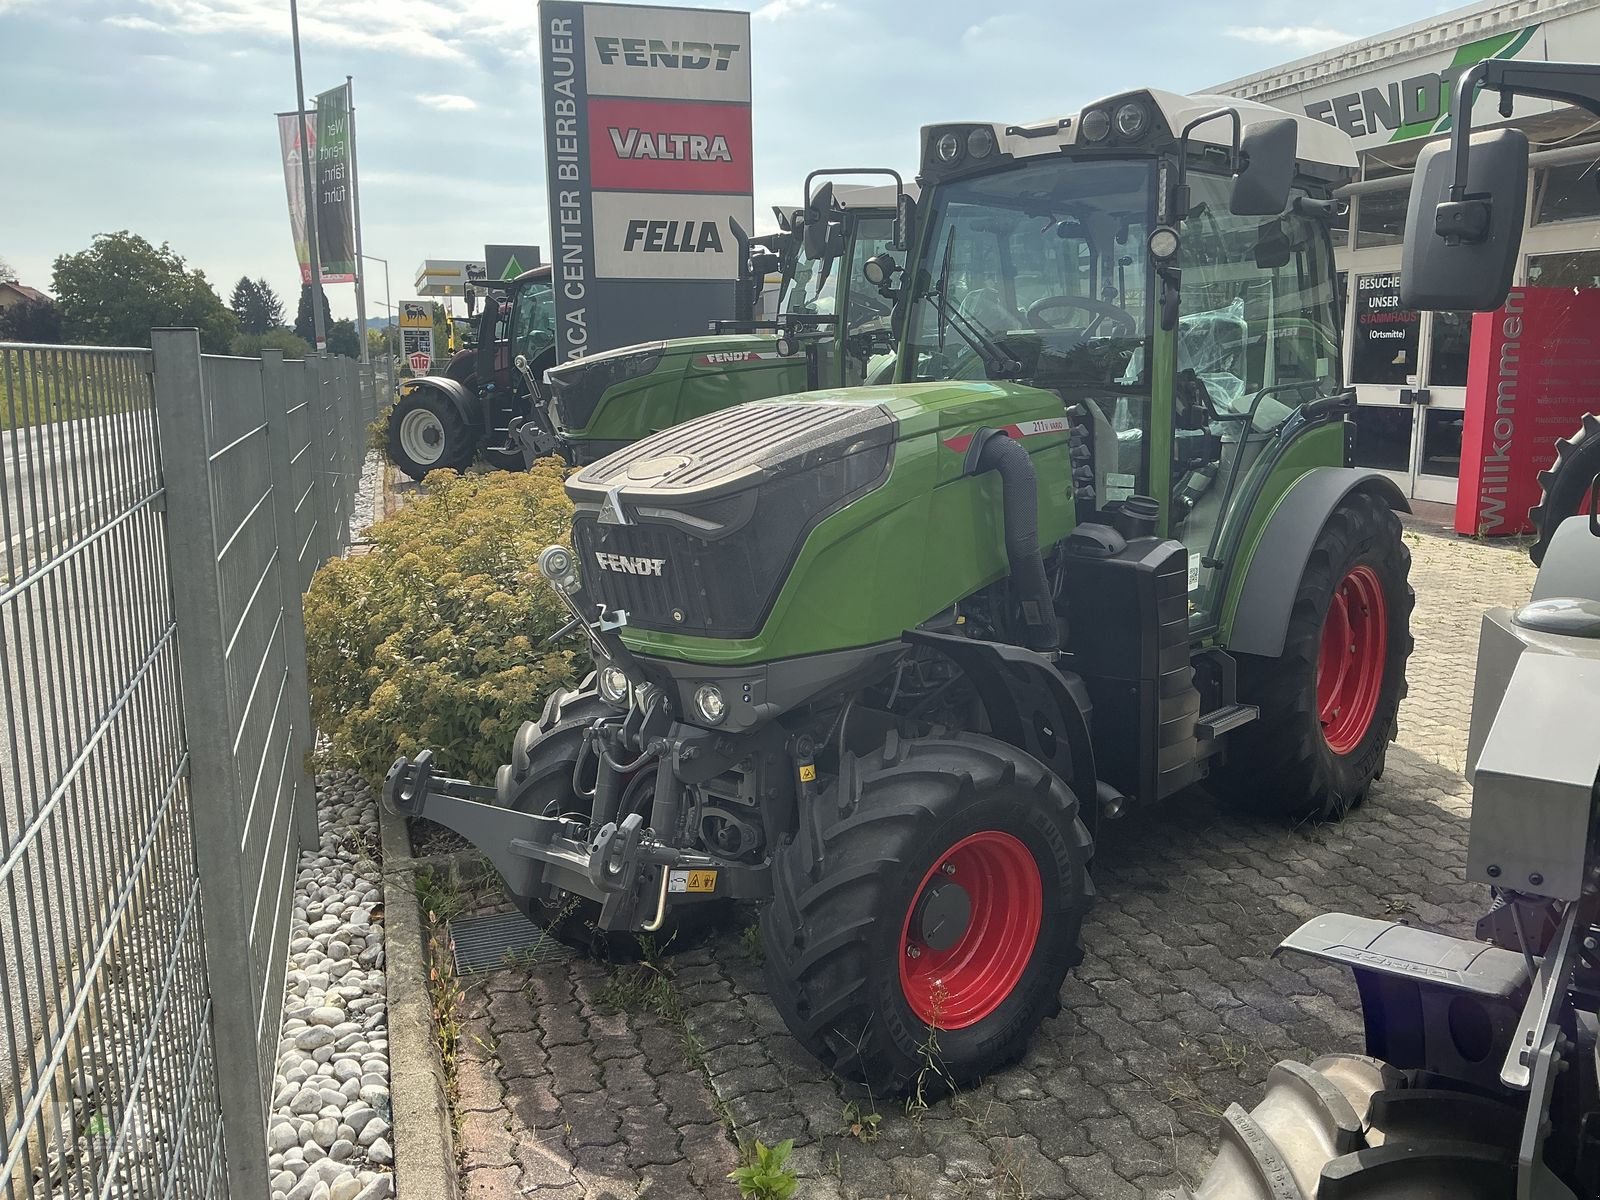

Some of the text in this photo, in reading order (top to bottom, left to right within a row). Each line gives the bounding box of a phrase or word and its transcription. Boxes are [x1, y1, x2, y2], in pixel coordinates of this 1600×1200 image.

[594, 36, 741, 71] FENDT
[607, 127, 734, 163] VALTRA
[551, 17, 588, 360] ACA CENTER BIERBAUER
[622, 219, 725, 253] FELLA
[1360, 276, 1400, 290] BESUCHE
[1369, 296, 1399, 307] UNSER
[1360, 311, 1417, 323] STAMMHAUS
[1370, 329, 1406, 339] (Ortsmitte)
[410, 354, 429, 369] UTA
[706, 352, 752, 364] FENDT
[1480, 291, 1526, 529] Willkommen
[1033, 421, 1044, 432] 211
[595, 551, 667, 577] FENDT
